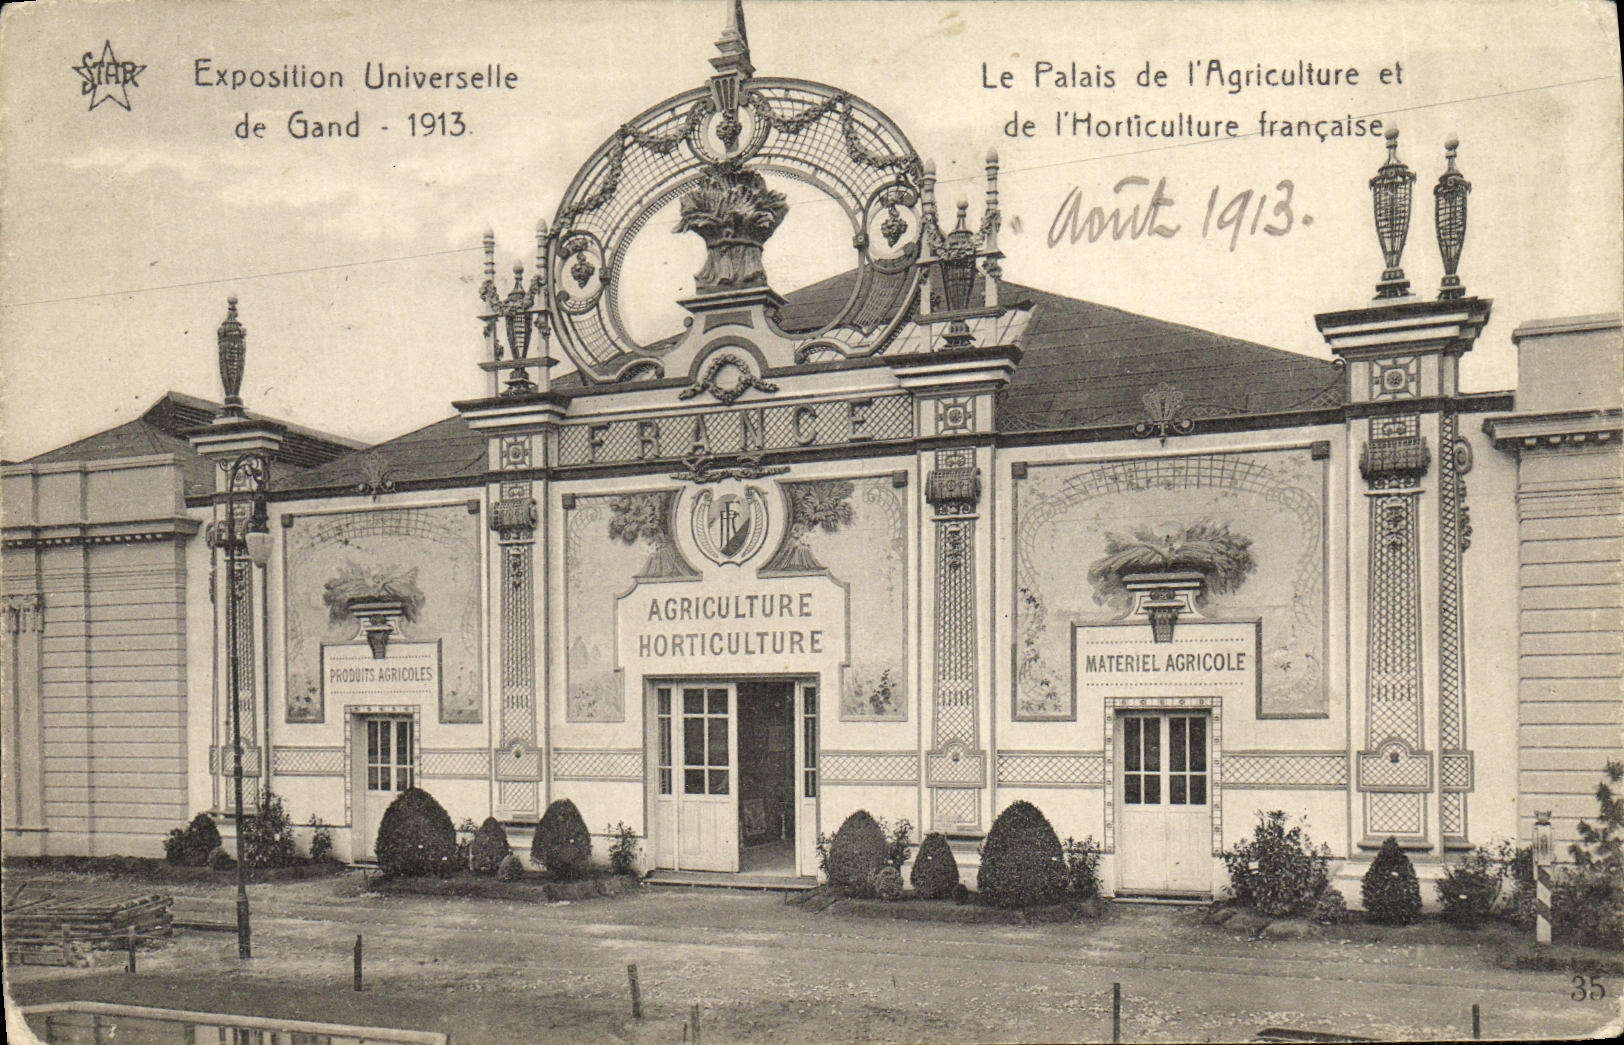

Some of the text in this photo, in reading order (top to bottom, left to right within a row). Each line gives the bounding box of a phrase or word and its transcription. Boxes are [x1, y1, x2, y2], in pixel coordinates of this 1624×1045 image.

[590, 401, 873, 459] FRANCE
[648, 593, 813, 622] AGRICULTURE
[639, 630, 823, 658] HORTICULTURE
[330, 666, 433, 683] PRODUITS AGRICOLES
[1165, 652, 1246, 672] AGRICOLE
